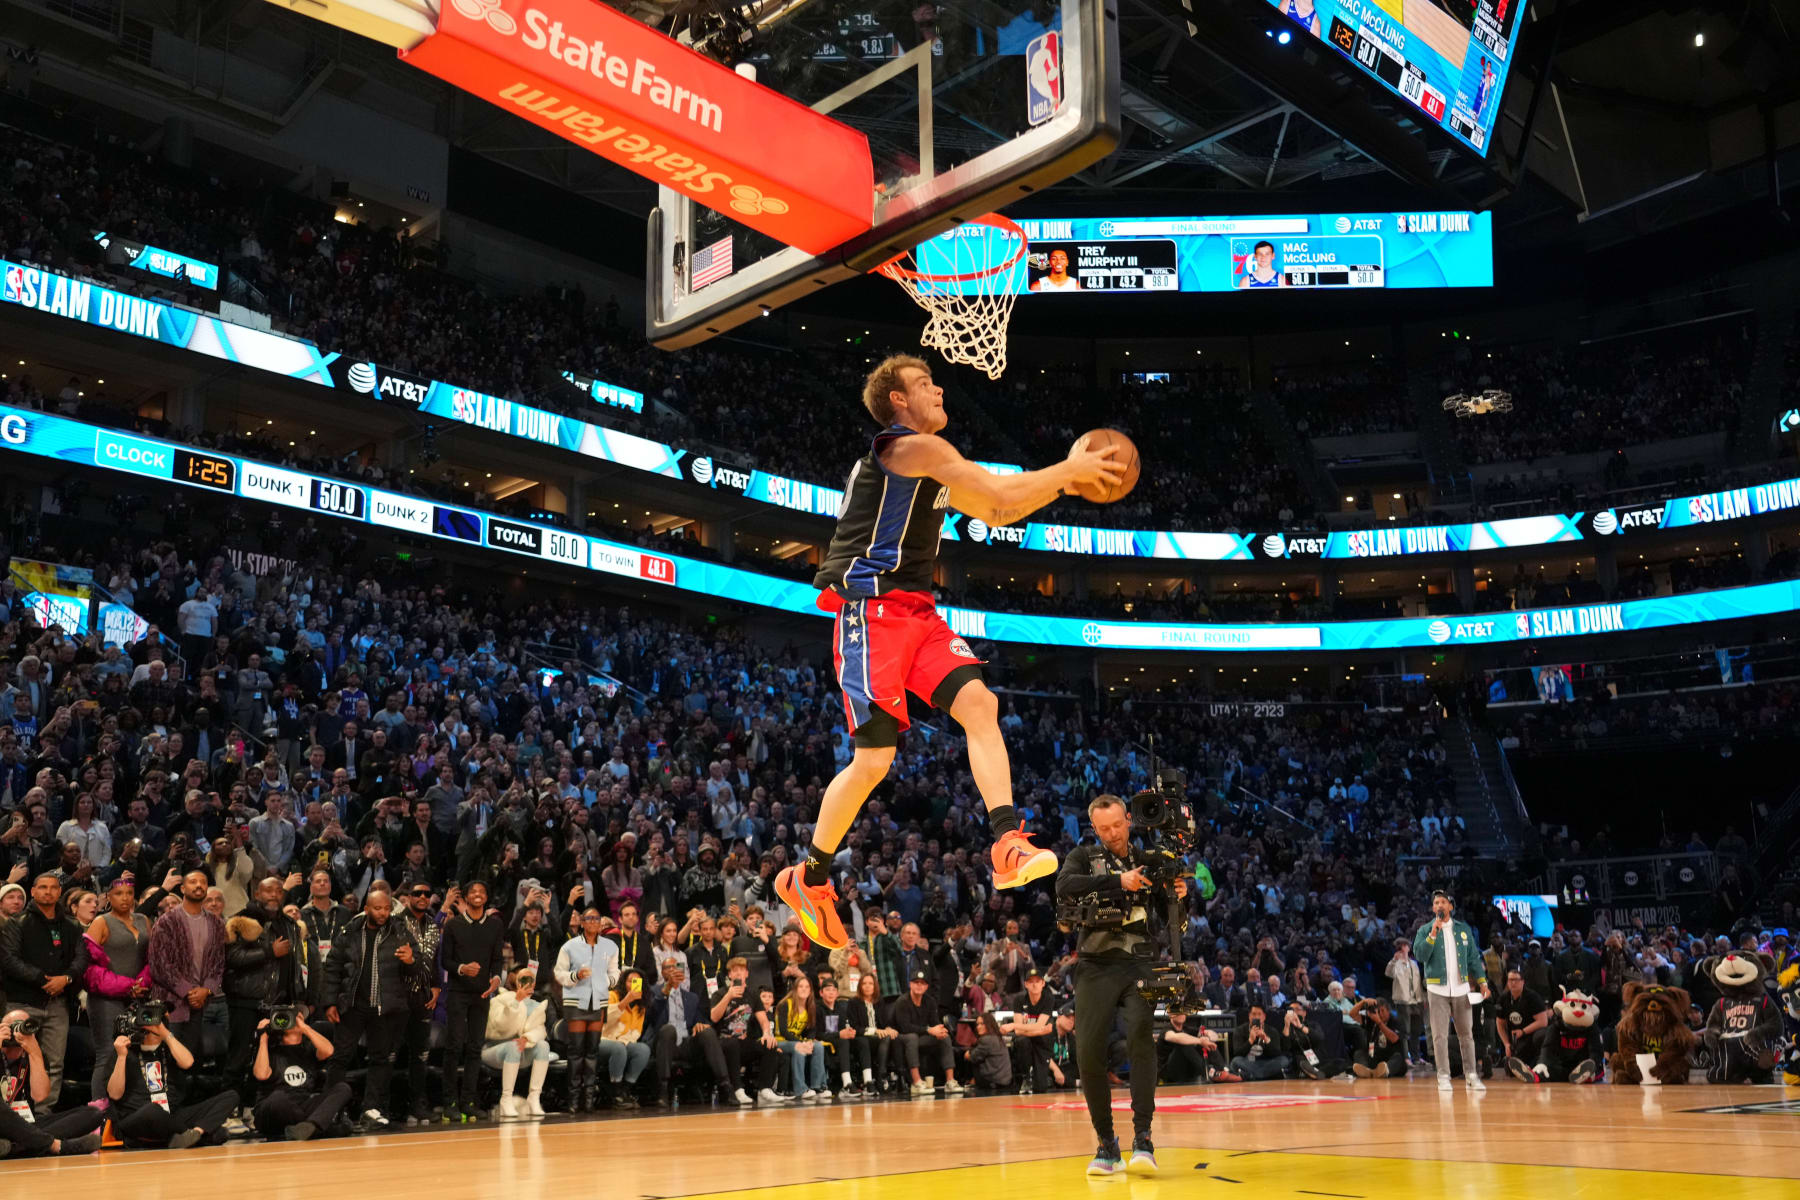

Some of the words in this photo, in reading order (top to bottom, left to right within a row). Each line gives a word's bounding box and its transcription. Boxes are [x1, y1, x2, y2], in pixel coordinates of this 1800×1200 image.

[1335, 24, 1353, 49] 1:25
[1361, 6, 1405, 50] McCLUNG
[1358, 39, 1376, 67] 50.0
[1405, 74, 1421, 100] 50.0
[1033, 101, 1049, 120] NBA
[1043, 221, 1072, 239] DUNK
[1354, 219, 1382, 230] AT&T
[1409, 214, 1437, 232] SLAM
[1441, 214, 1470, 232] DUNK
[1077, 246, 1106, 256] TREY
[1283, 243, 1308, 252] MAC
[1284, 253, 1335, 263] McCLUNG
[1078, 256, 1125, 267] MURPHY
[1128, 256, 1138, 266] III
[1119, 275, 1136, 288] 49.2
[1292, 273, 1309, 285] 50.0
[1357, 272, 1374, 283] 50.0
[21, 268, 90, 322] SLAM
[99, 290, 161, 339] DUNK
[380, 376, 428, 403] AT&T
[464, 390, 511, 433] SLAM
[517, 406, 561, 445] DUNK
[106, 443, 165, 468] CLOCK
[188, 457, 228, 485] 1:25
[715, 468, 750, 490] AT&T
[248, 474, 292, 494] DUNK
[298, 485, 304, 497] 1
[320, 482, 356, 514] 50.0
[776, 476, 813, 512] SLAM
[817, 488, 844, 517] DUN
[1701, 488, 1750, 523] SLAM
[376, 502, 417, 521] DUNK
[420, 512, 428, 523] 2
[1621, 508, 1664, 528] AT&T
[494, 526, 536, 548] TOTAL
[990, 527, 1025, 542] AT&T
[1054, 525, 1093, 554] SLAM
[1097, 530, 1135, 556] DUNK
[1359, 528, 1401, 557] SLAM
[1407, 527, 1449, 553] DUNK
[551, 534, 578, 560] 50.0
[1288, 539, 1327, 553] AT&T
[600, 552, 612, 563] TO
[616, 556, 634, 568] WIN
[647, 558, 666, 579] 48.1
[952, 608, 987, 637] DUNK
[1455, 622, 1494, 638] AT&T
[1533, 609, 1575, 636] SLAM
[1579, 605, 1624, 632] DUNK
[1161, 631, 1199, 643] FINAL
[1204, 632, 1251, 644] ROUND
[1658, 906, 1681, 924] 2023
[286, 1070, 306, 1082] TNT
